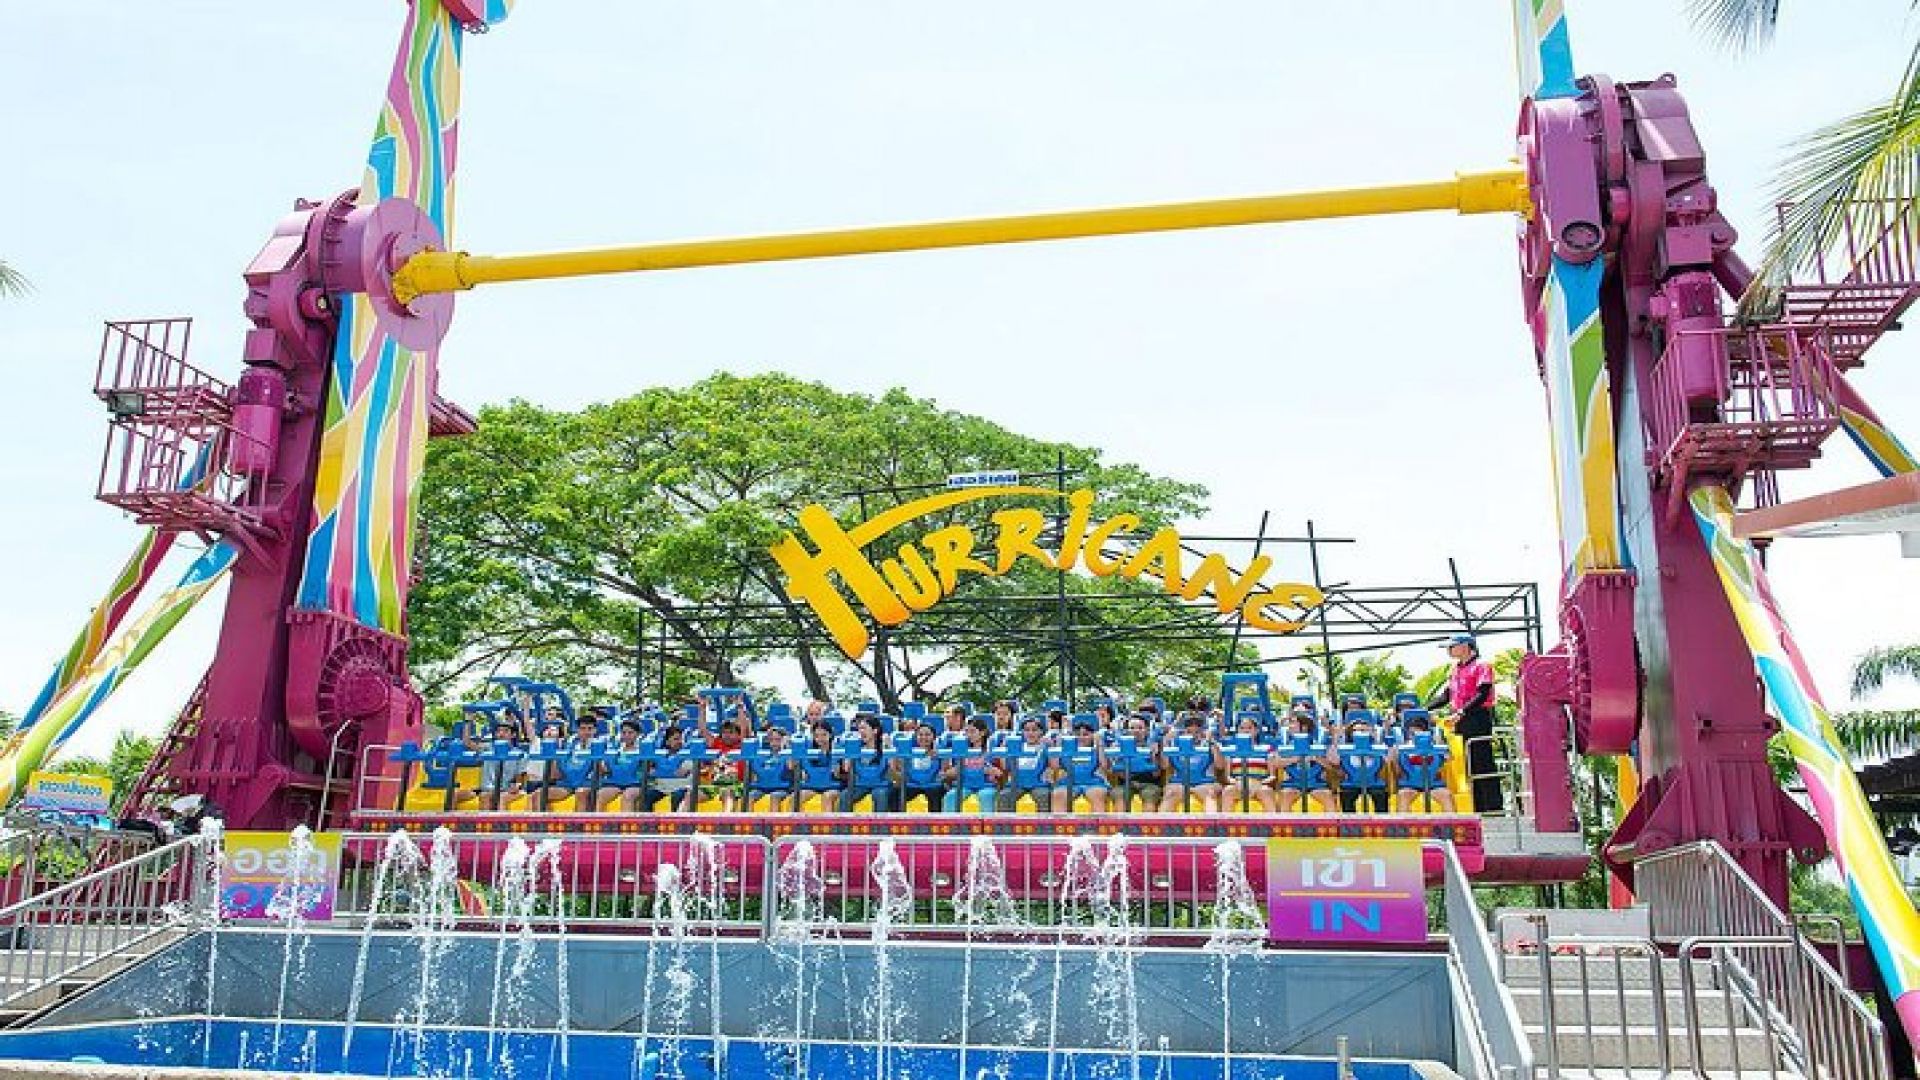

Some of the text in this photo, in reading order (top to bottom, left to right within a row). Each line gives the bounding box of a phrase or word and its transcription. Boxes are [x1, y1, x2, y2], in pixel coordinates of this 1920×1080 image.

[769, 488, 1325, 660] HURRICANE
[1301, 847, 1387, 888] เข้า
[1310, 901, 1382, 932] IN
